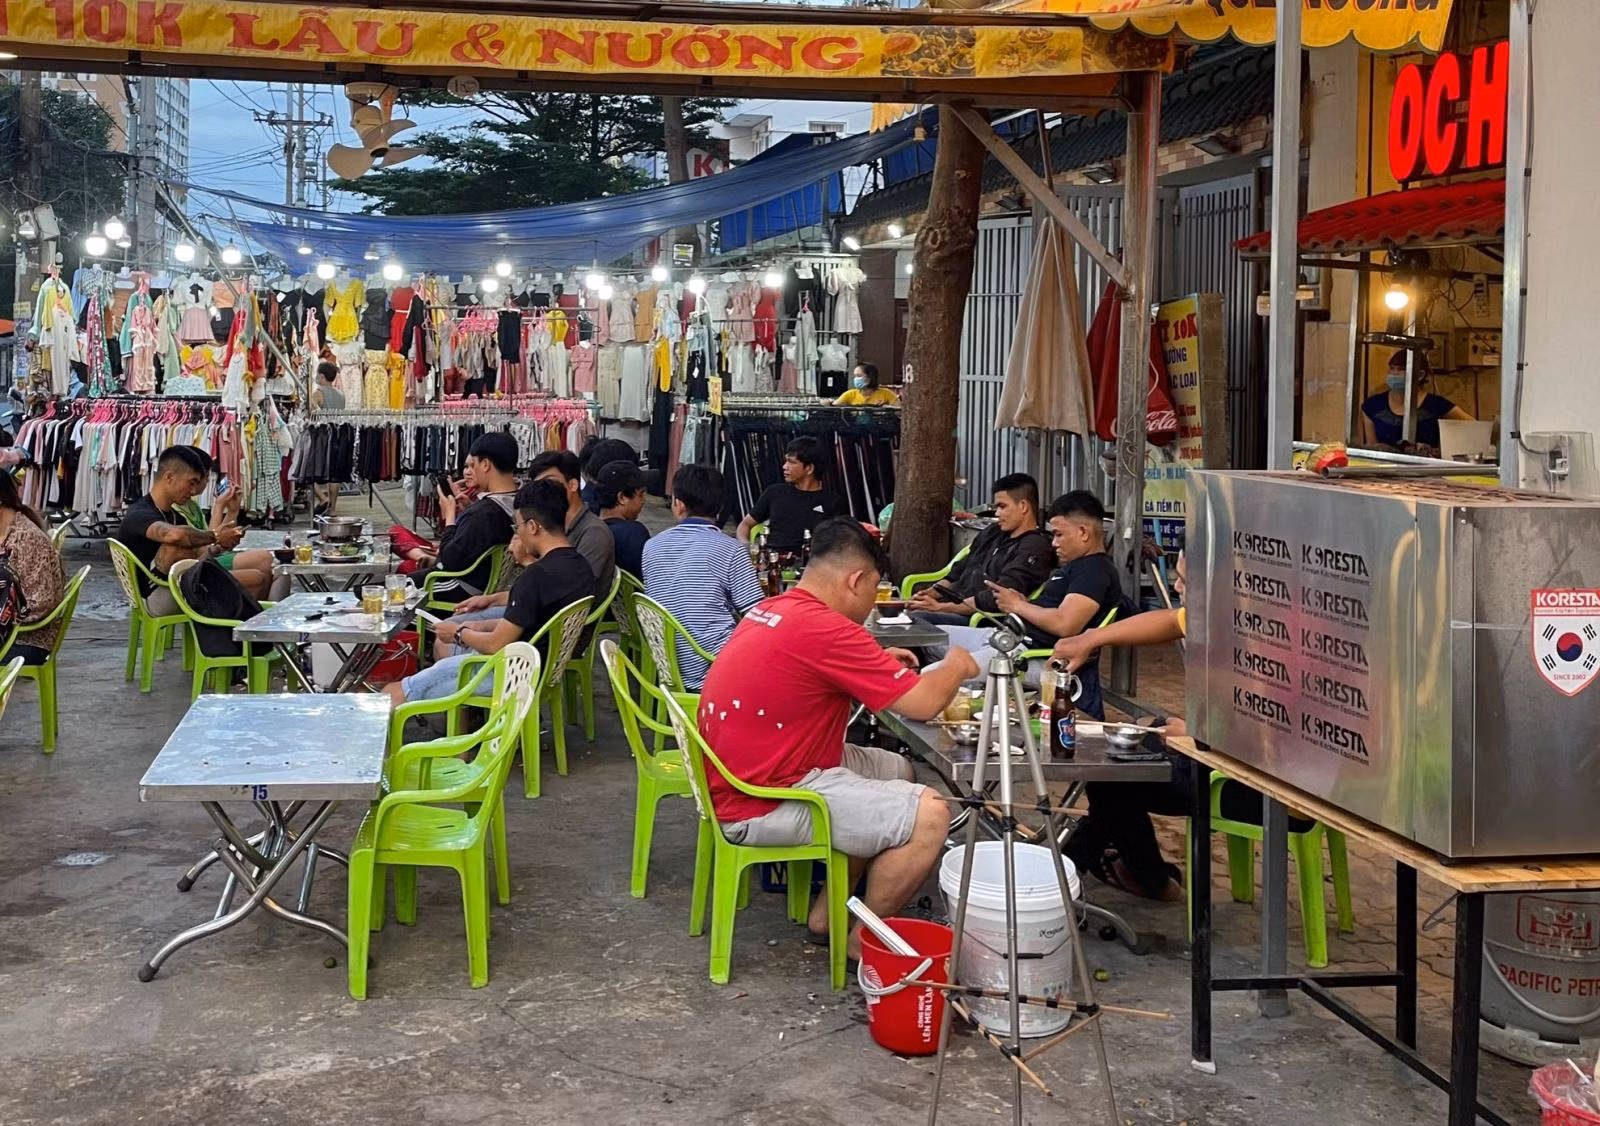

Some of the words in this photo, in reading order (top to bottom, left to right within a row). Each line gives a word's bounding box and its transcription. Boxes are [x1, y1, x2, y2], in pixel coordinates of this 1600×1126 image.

[45, 0, 184, 46] 10K
[450, 23, 505, 65] &
[1536, 592, 1600, 606] KORESTA
[251, 784, 268, 800] 15
[1499, 963, 1562, 994] PACIFIC
